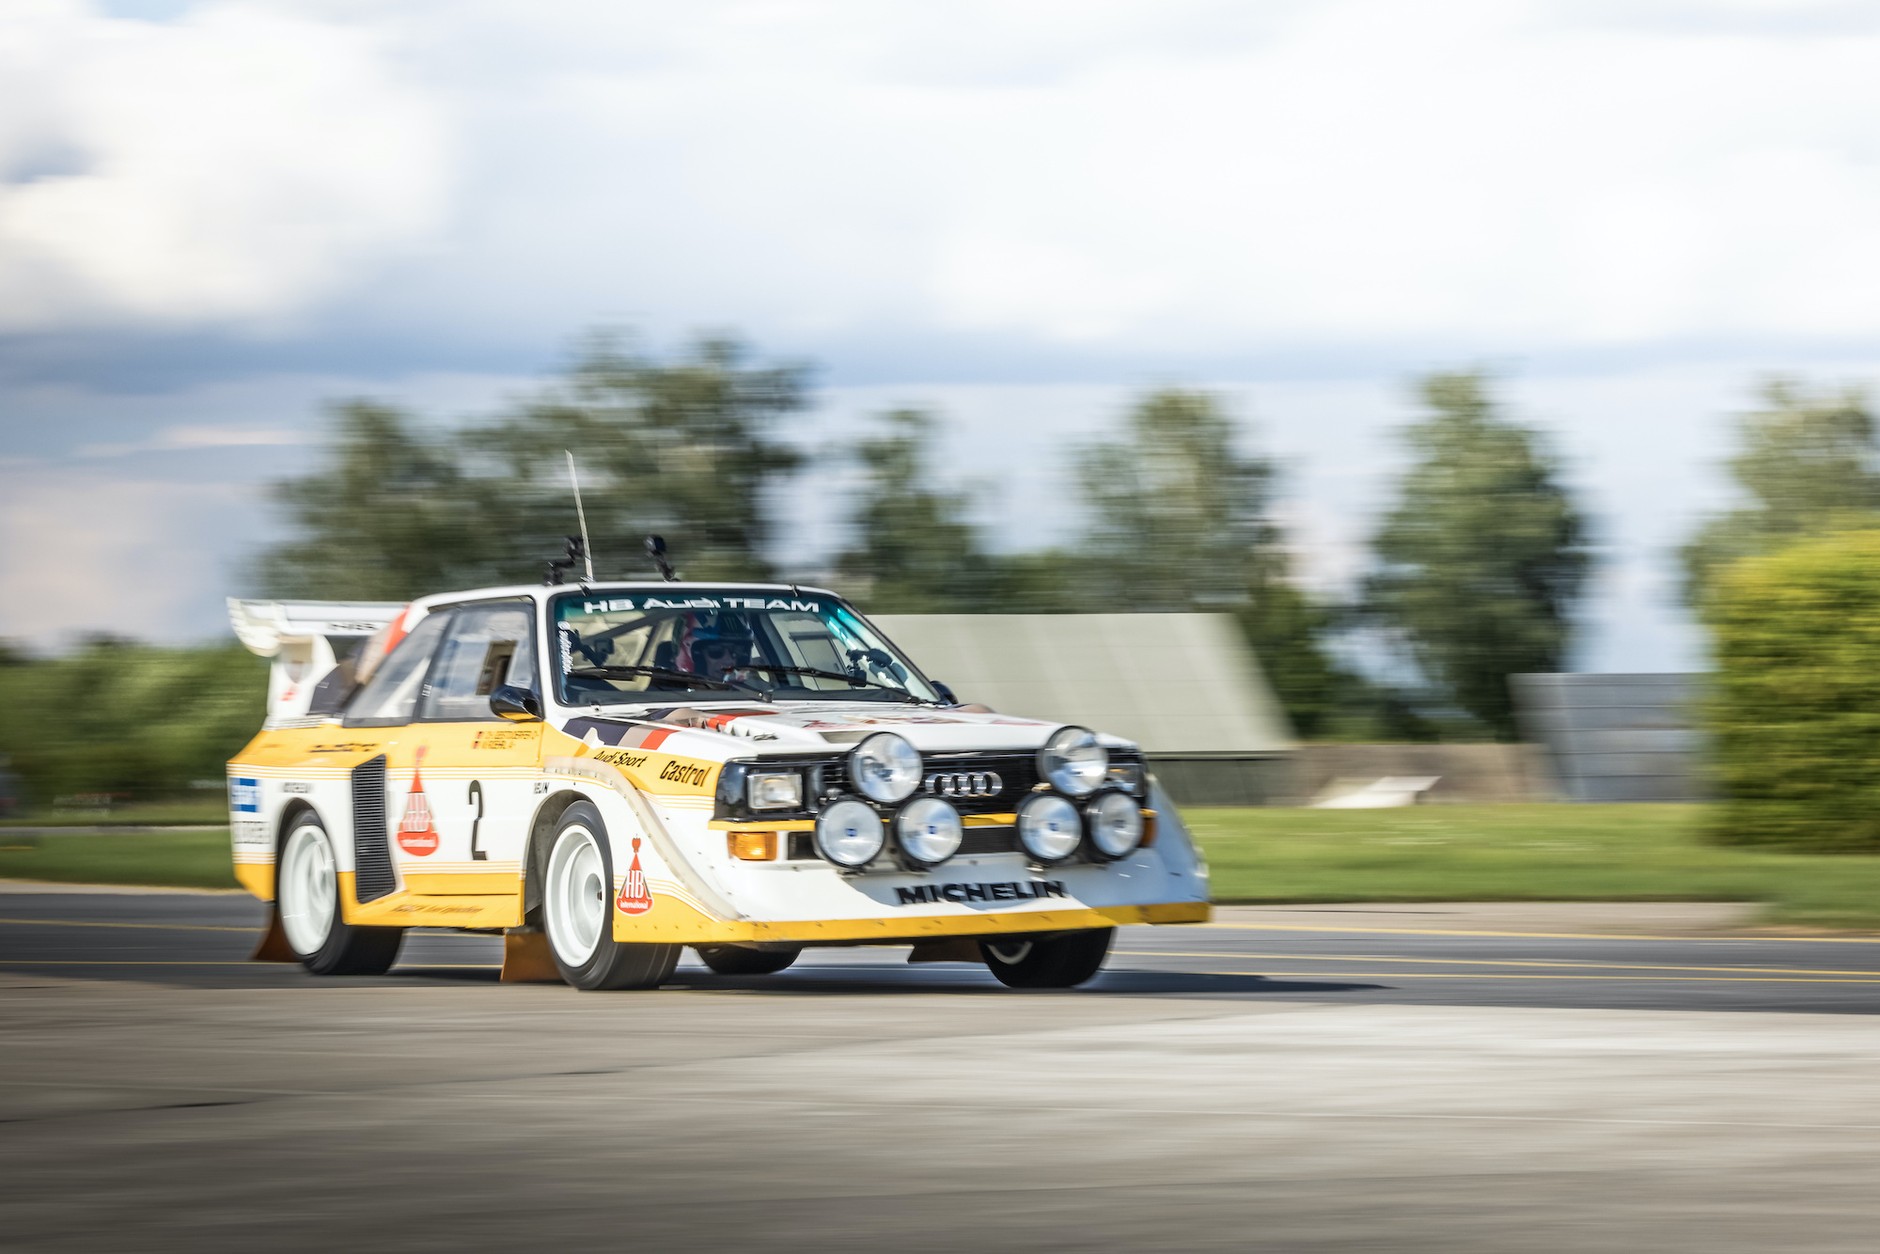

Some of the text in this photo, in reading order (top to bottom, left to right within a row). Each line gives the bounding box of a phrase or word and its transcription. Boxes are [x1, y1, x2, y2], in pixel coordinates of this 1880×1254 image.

[584, 601, 635, 614] HB
[723, 598, 820, 613] TEAM
[593, 750, 648, 767] Audi Sport
[659, 760, 712, 787] Castrol
[469, 780, 487, 860] 2
[625, 870, 645, 898] HB
[893, 880, 1068, 905] MICHELIN
